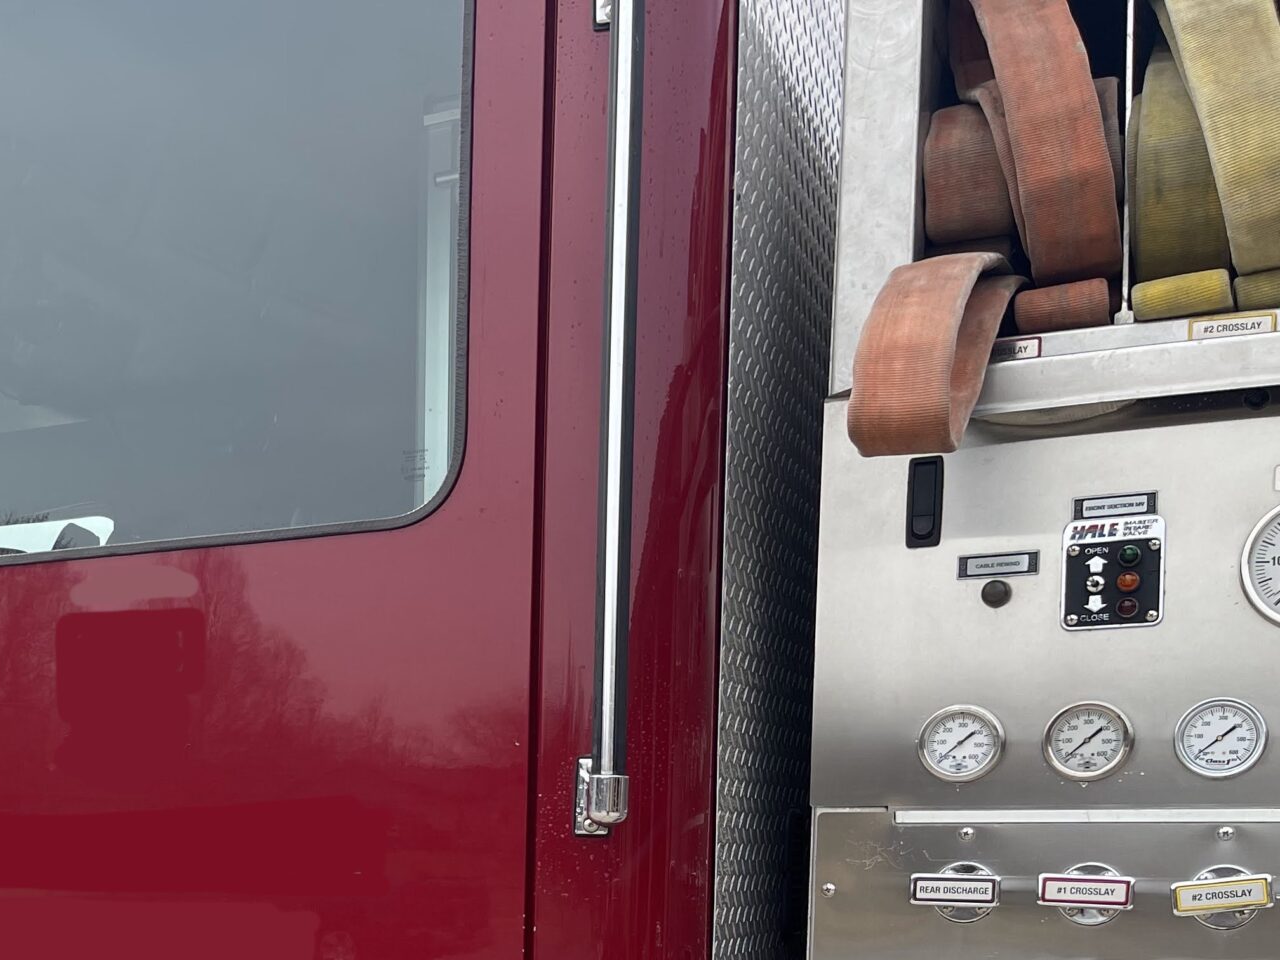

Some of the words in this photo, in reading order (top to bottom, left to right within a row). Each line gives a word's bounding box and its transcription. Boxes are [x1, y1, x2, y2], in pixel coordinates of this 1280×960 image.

[1216, 321, 1262, 332] CROSSLAY
[1070, 523, 1119, 540] HALE
[1080, 613, 1109, 621] CLOSE
[919, 885, 941, 894] REAR
[943, 886, 990, 895] DISCHARGE
[1069, 886, 1116, 896] CROSSLAY
[1192, 893, 1203, 901] #2
[1205, 888, 1253, 900] CROSSLAY
